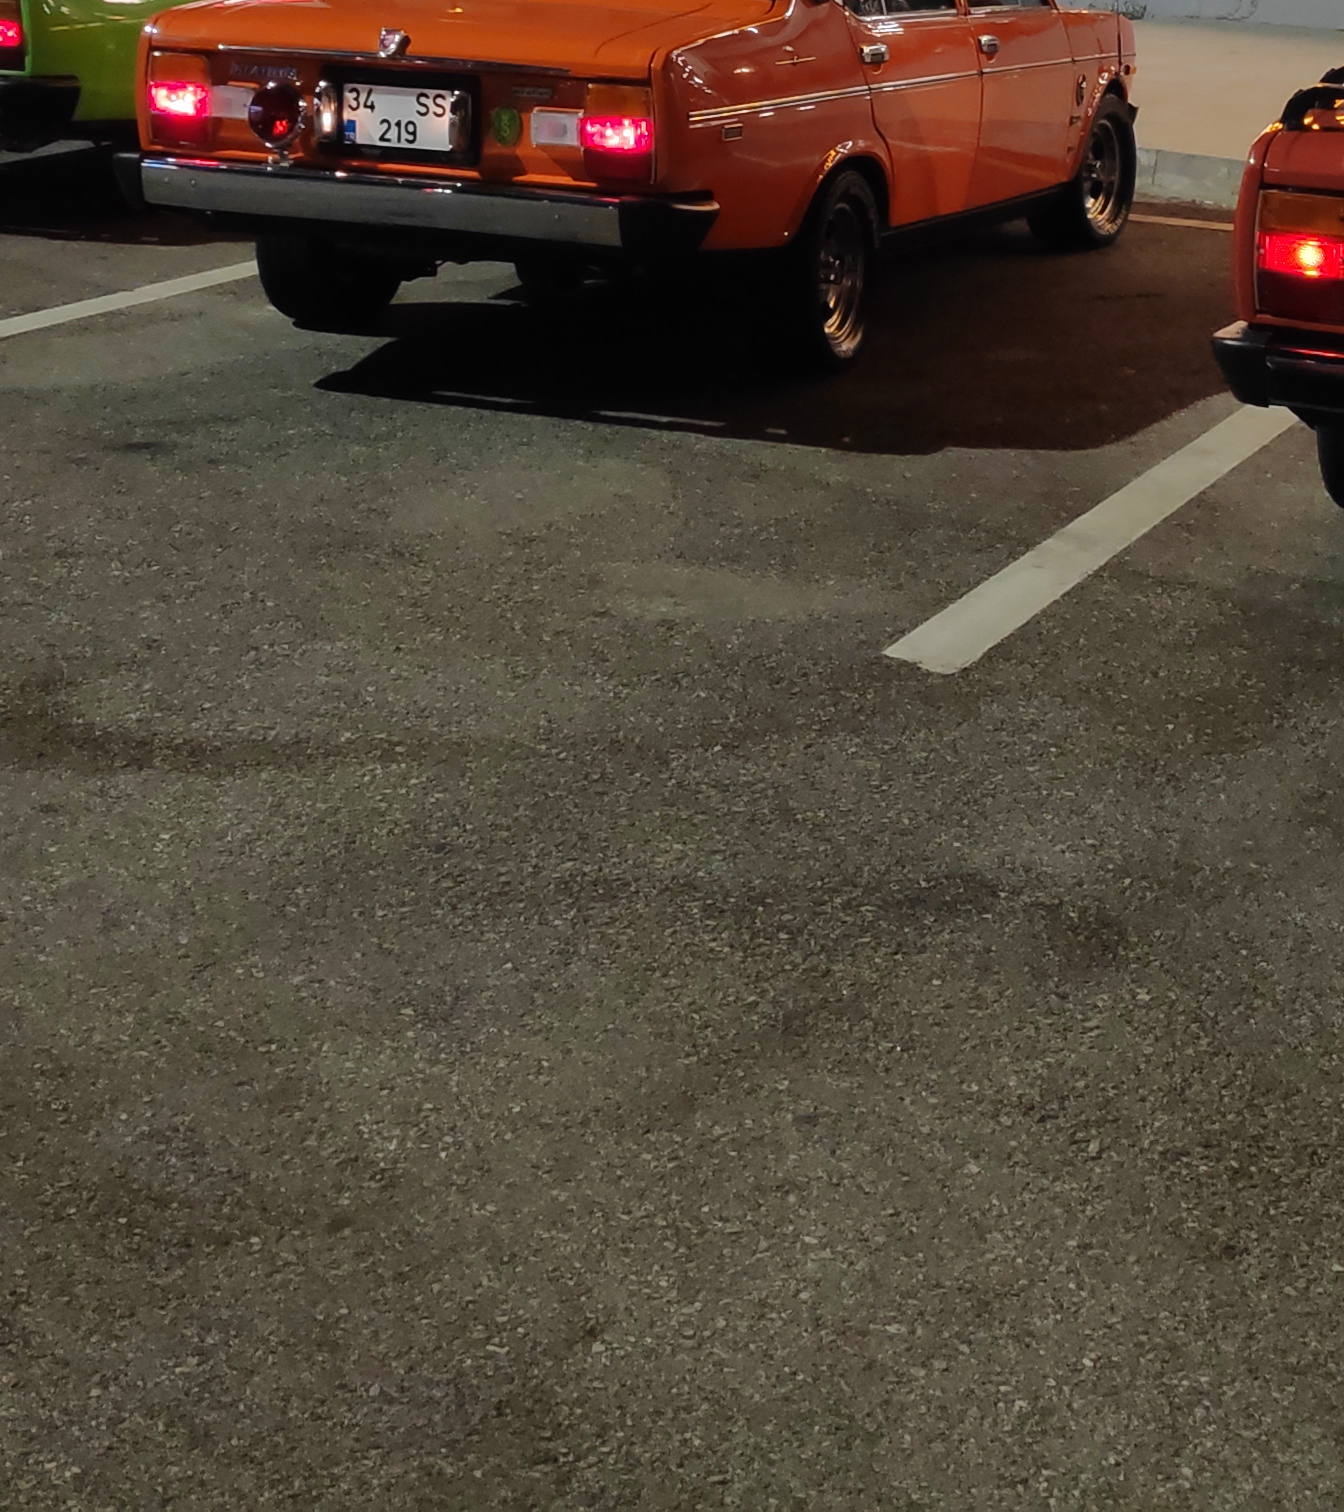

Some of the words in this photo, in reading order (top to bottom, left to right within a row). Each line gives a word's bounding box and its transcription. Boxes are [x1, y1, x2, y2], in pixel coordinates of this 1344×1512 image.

[347, 88, 376, 113] 34
[415, 91, 447, 118] SS
[378, 118, 417, 144] 219
